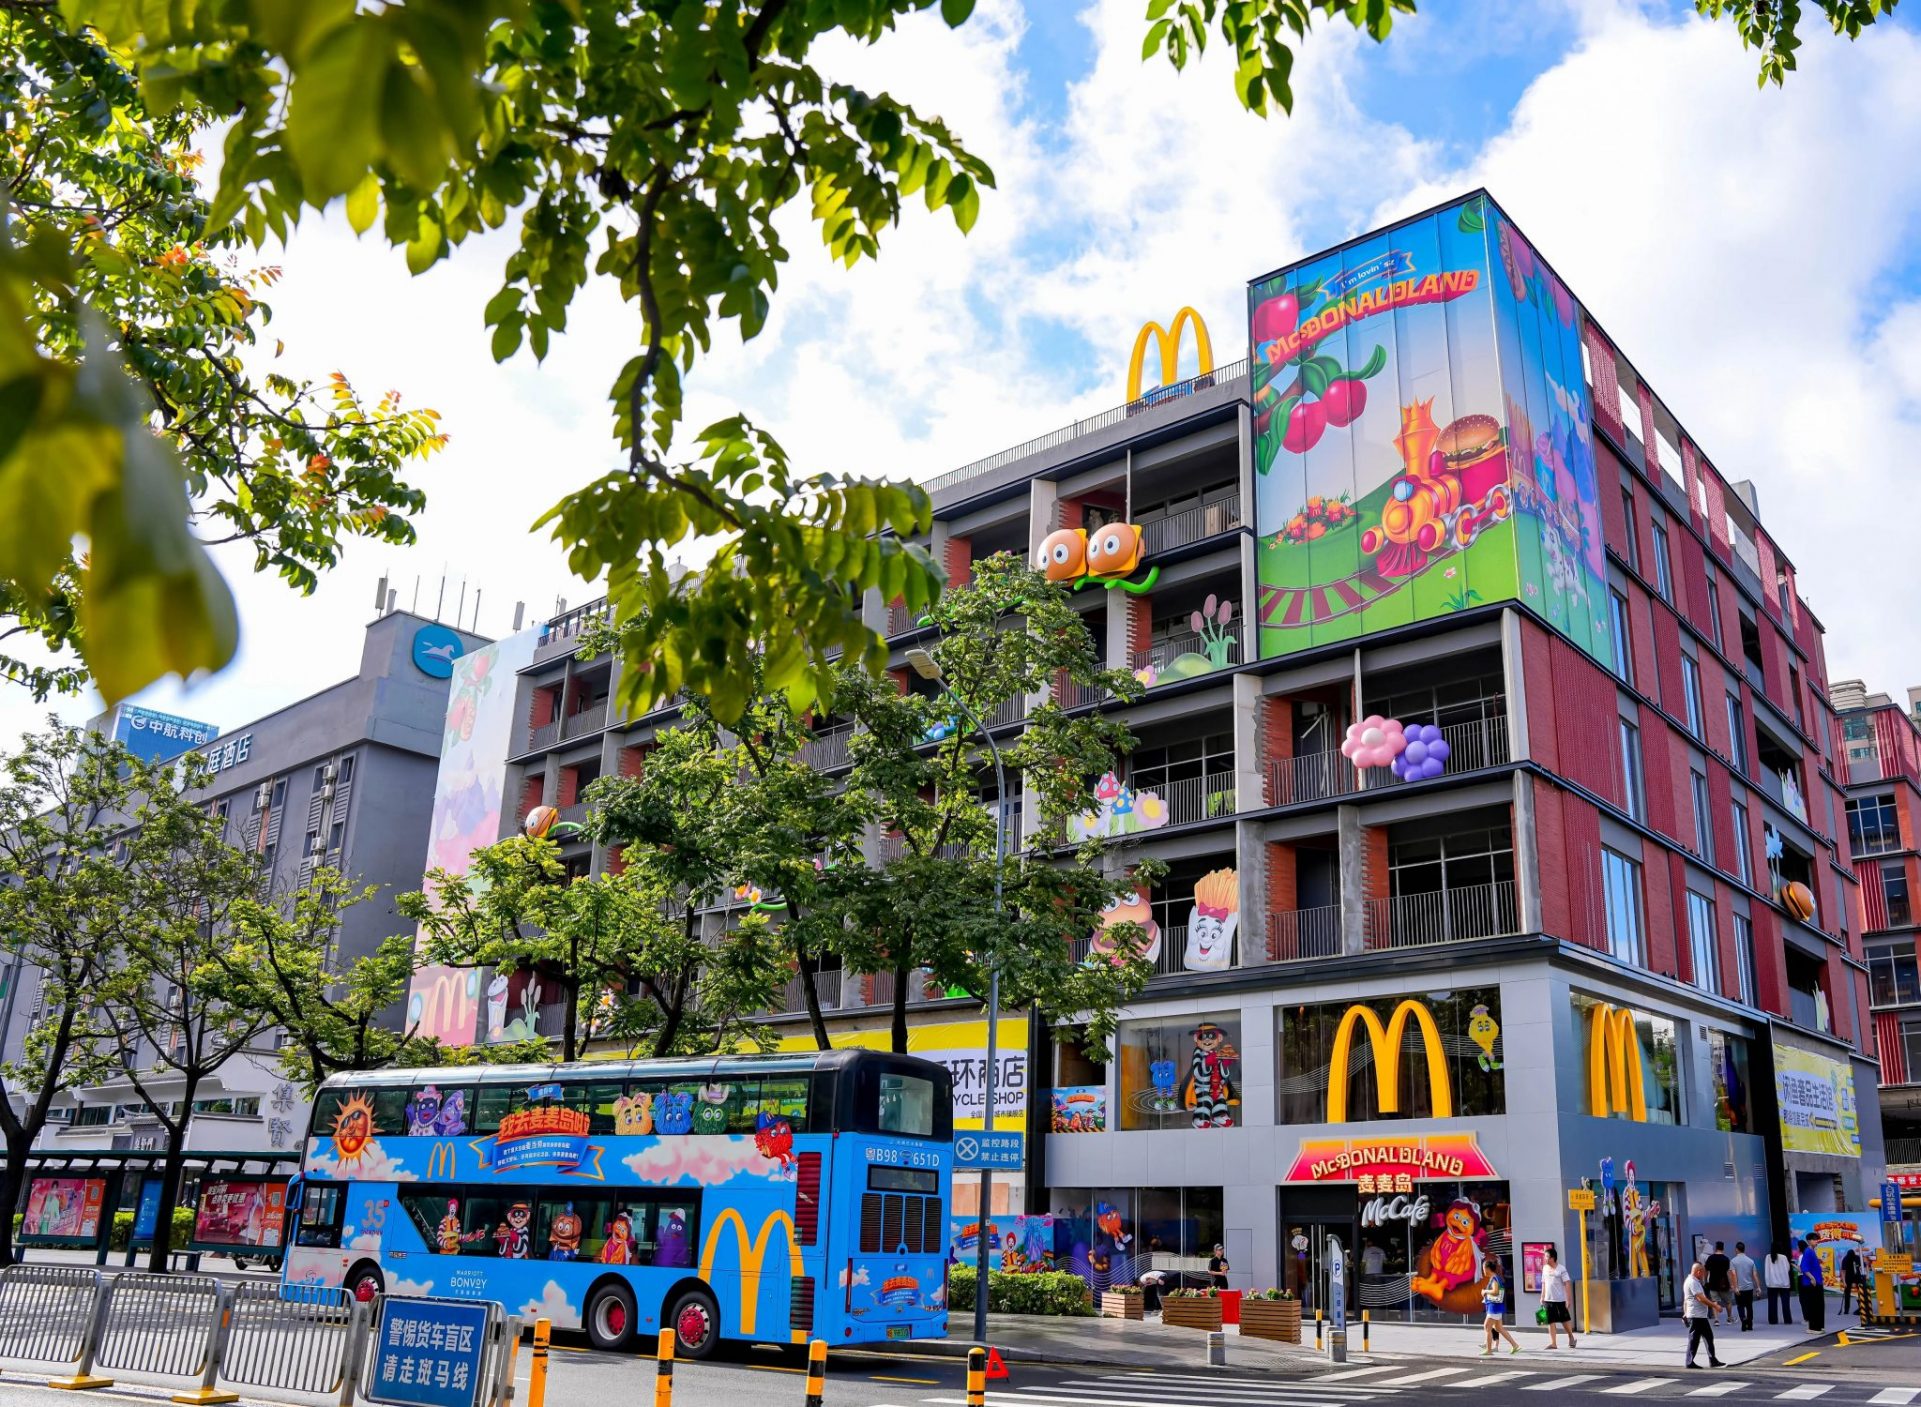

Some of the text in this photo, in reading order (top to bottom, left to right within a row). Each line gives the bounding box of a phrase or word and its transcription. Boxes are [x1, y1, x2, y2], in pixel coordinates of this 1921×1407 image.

[149, 720, 208, 745] 中航科创
[936, 1056, 1025, 1089] 环商店
[981, 1139, 1019, 1149] 监控路段
[981, 1152, 1019, 1162] 禁止违停
[1358, 1173, 1413, 1194] 麦麦岛
[1361, 1194, 1430, 1228] McCafé
[388, 1317, 475, 1353] 警惕货车盲区
[382, 1353, 469, 1391] 请走斑马线
